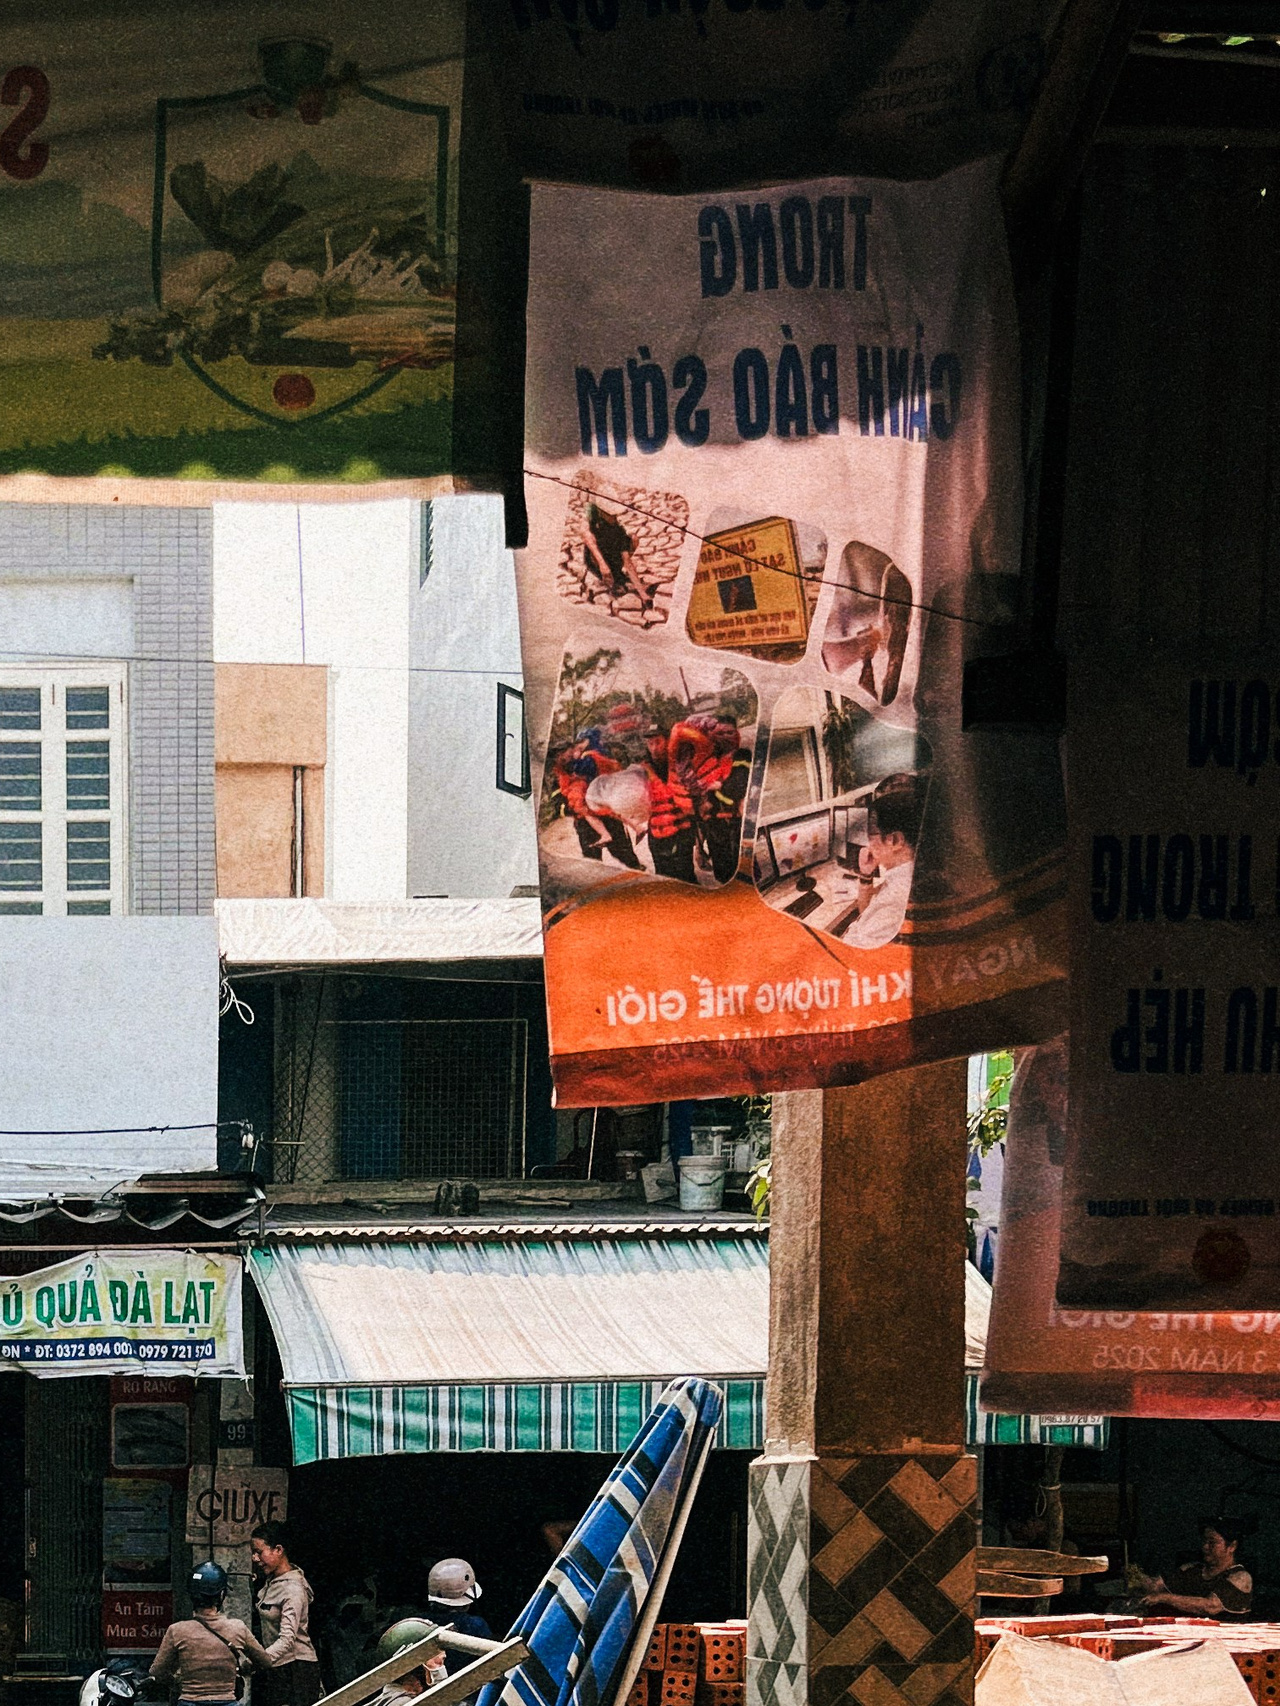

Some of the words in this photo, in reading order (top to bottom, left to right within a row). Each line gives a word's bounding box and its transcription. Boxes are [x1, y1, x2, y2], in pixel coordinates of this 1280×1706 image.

[1091, 834, 1255, 922] TRONG
[35, 1264, 101, 1331] QUẢ
[109, 1270, 147, 1325] ĐÀ
[164, 1280, 217, 1335] LẠT
[34, 1345, 54, 1359] ĐT:
[56, 1343, 86, 1358] 0372
[88, 1342, 111, 1357] 894
[139, 1345, 168, 1359] 0979
[171, 1345, 192, 1359] 721
[226, 1423, 247, 1441] 99
[106, 1625, 137, 1638] Mua
